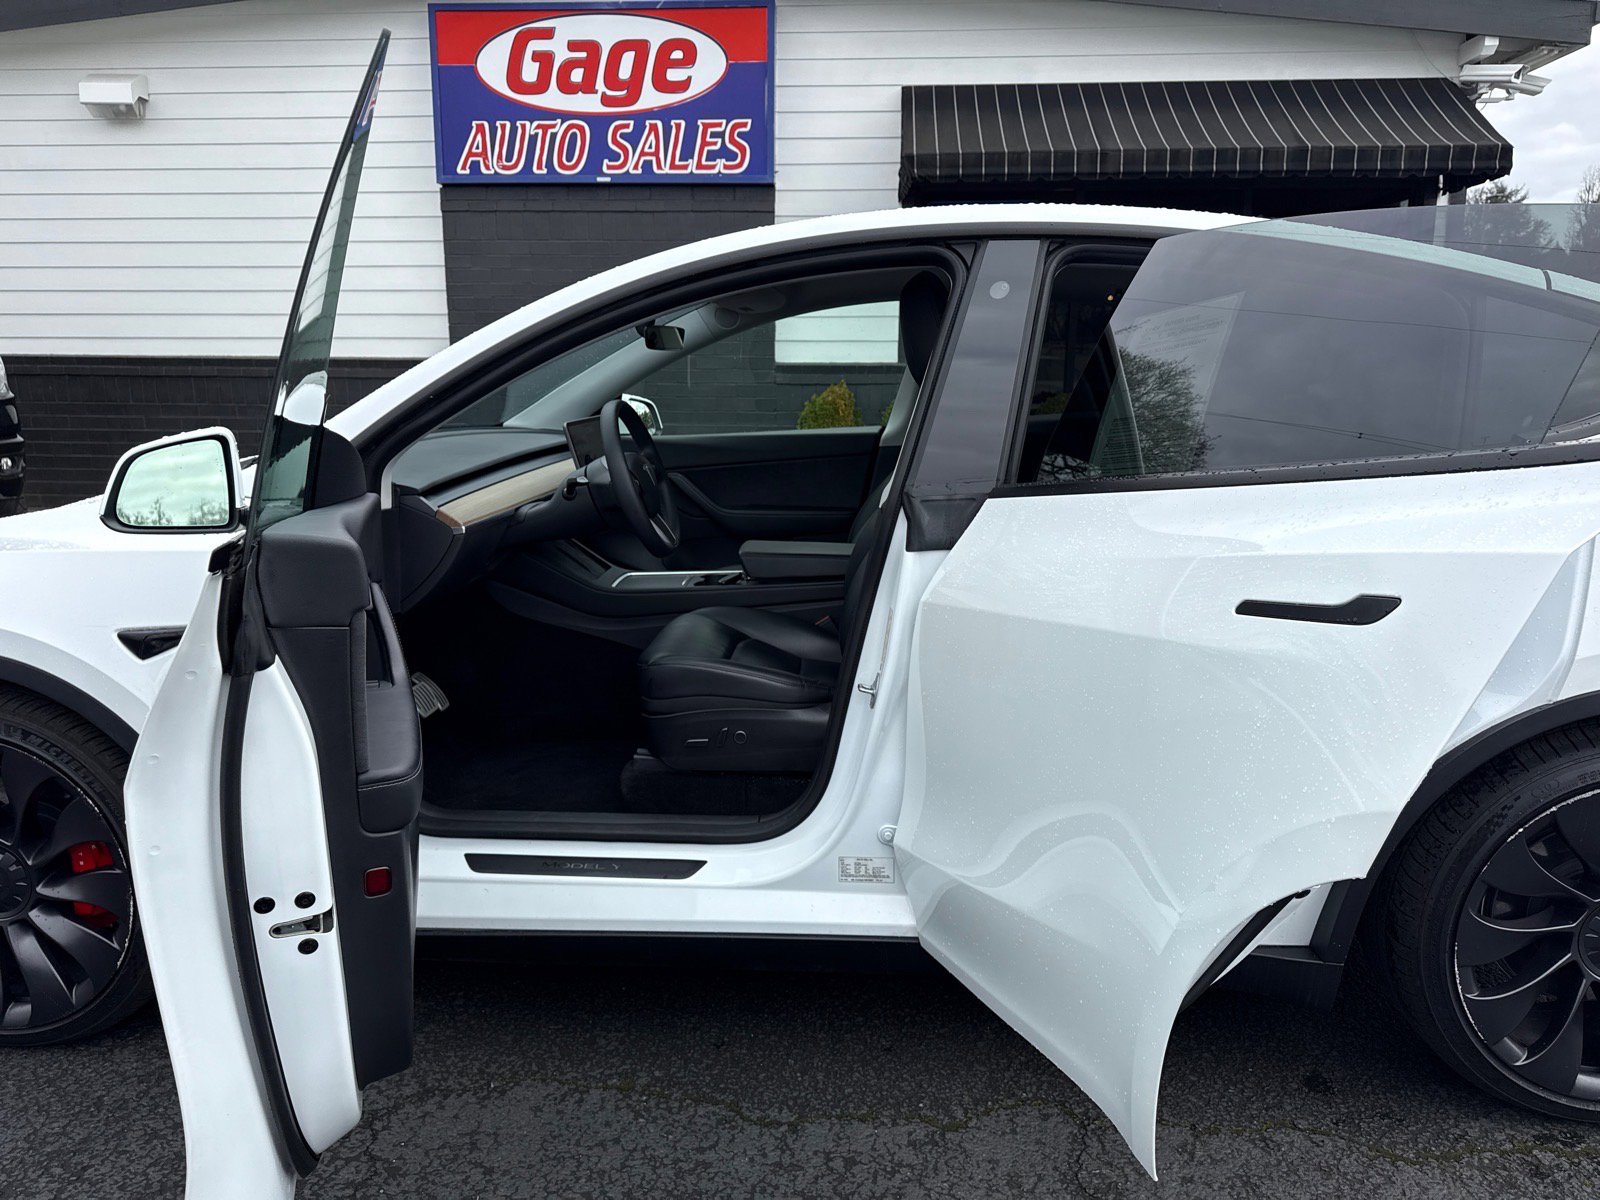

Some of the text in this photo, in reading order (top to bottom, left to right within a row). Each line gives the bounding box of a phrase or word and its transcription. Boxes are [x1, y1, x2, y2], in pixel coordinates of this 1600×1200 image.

[506, 27, 698, 107] Gage
[457, 119, 752, 175] AUTO SALES
[542, 861, 605, 870] MODEL
